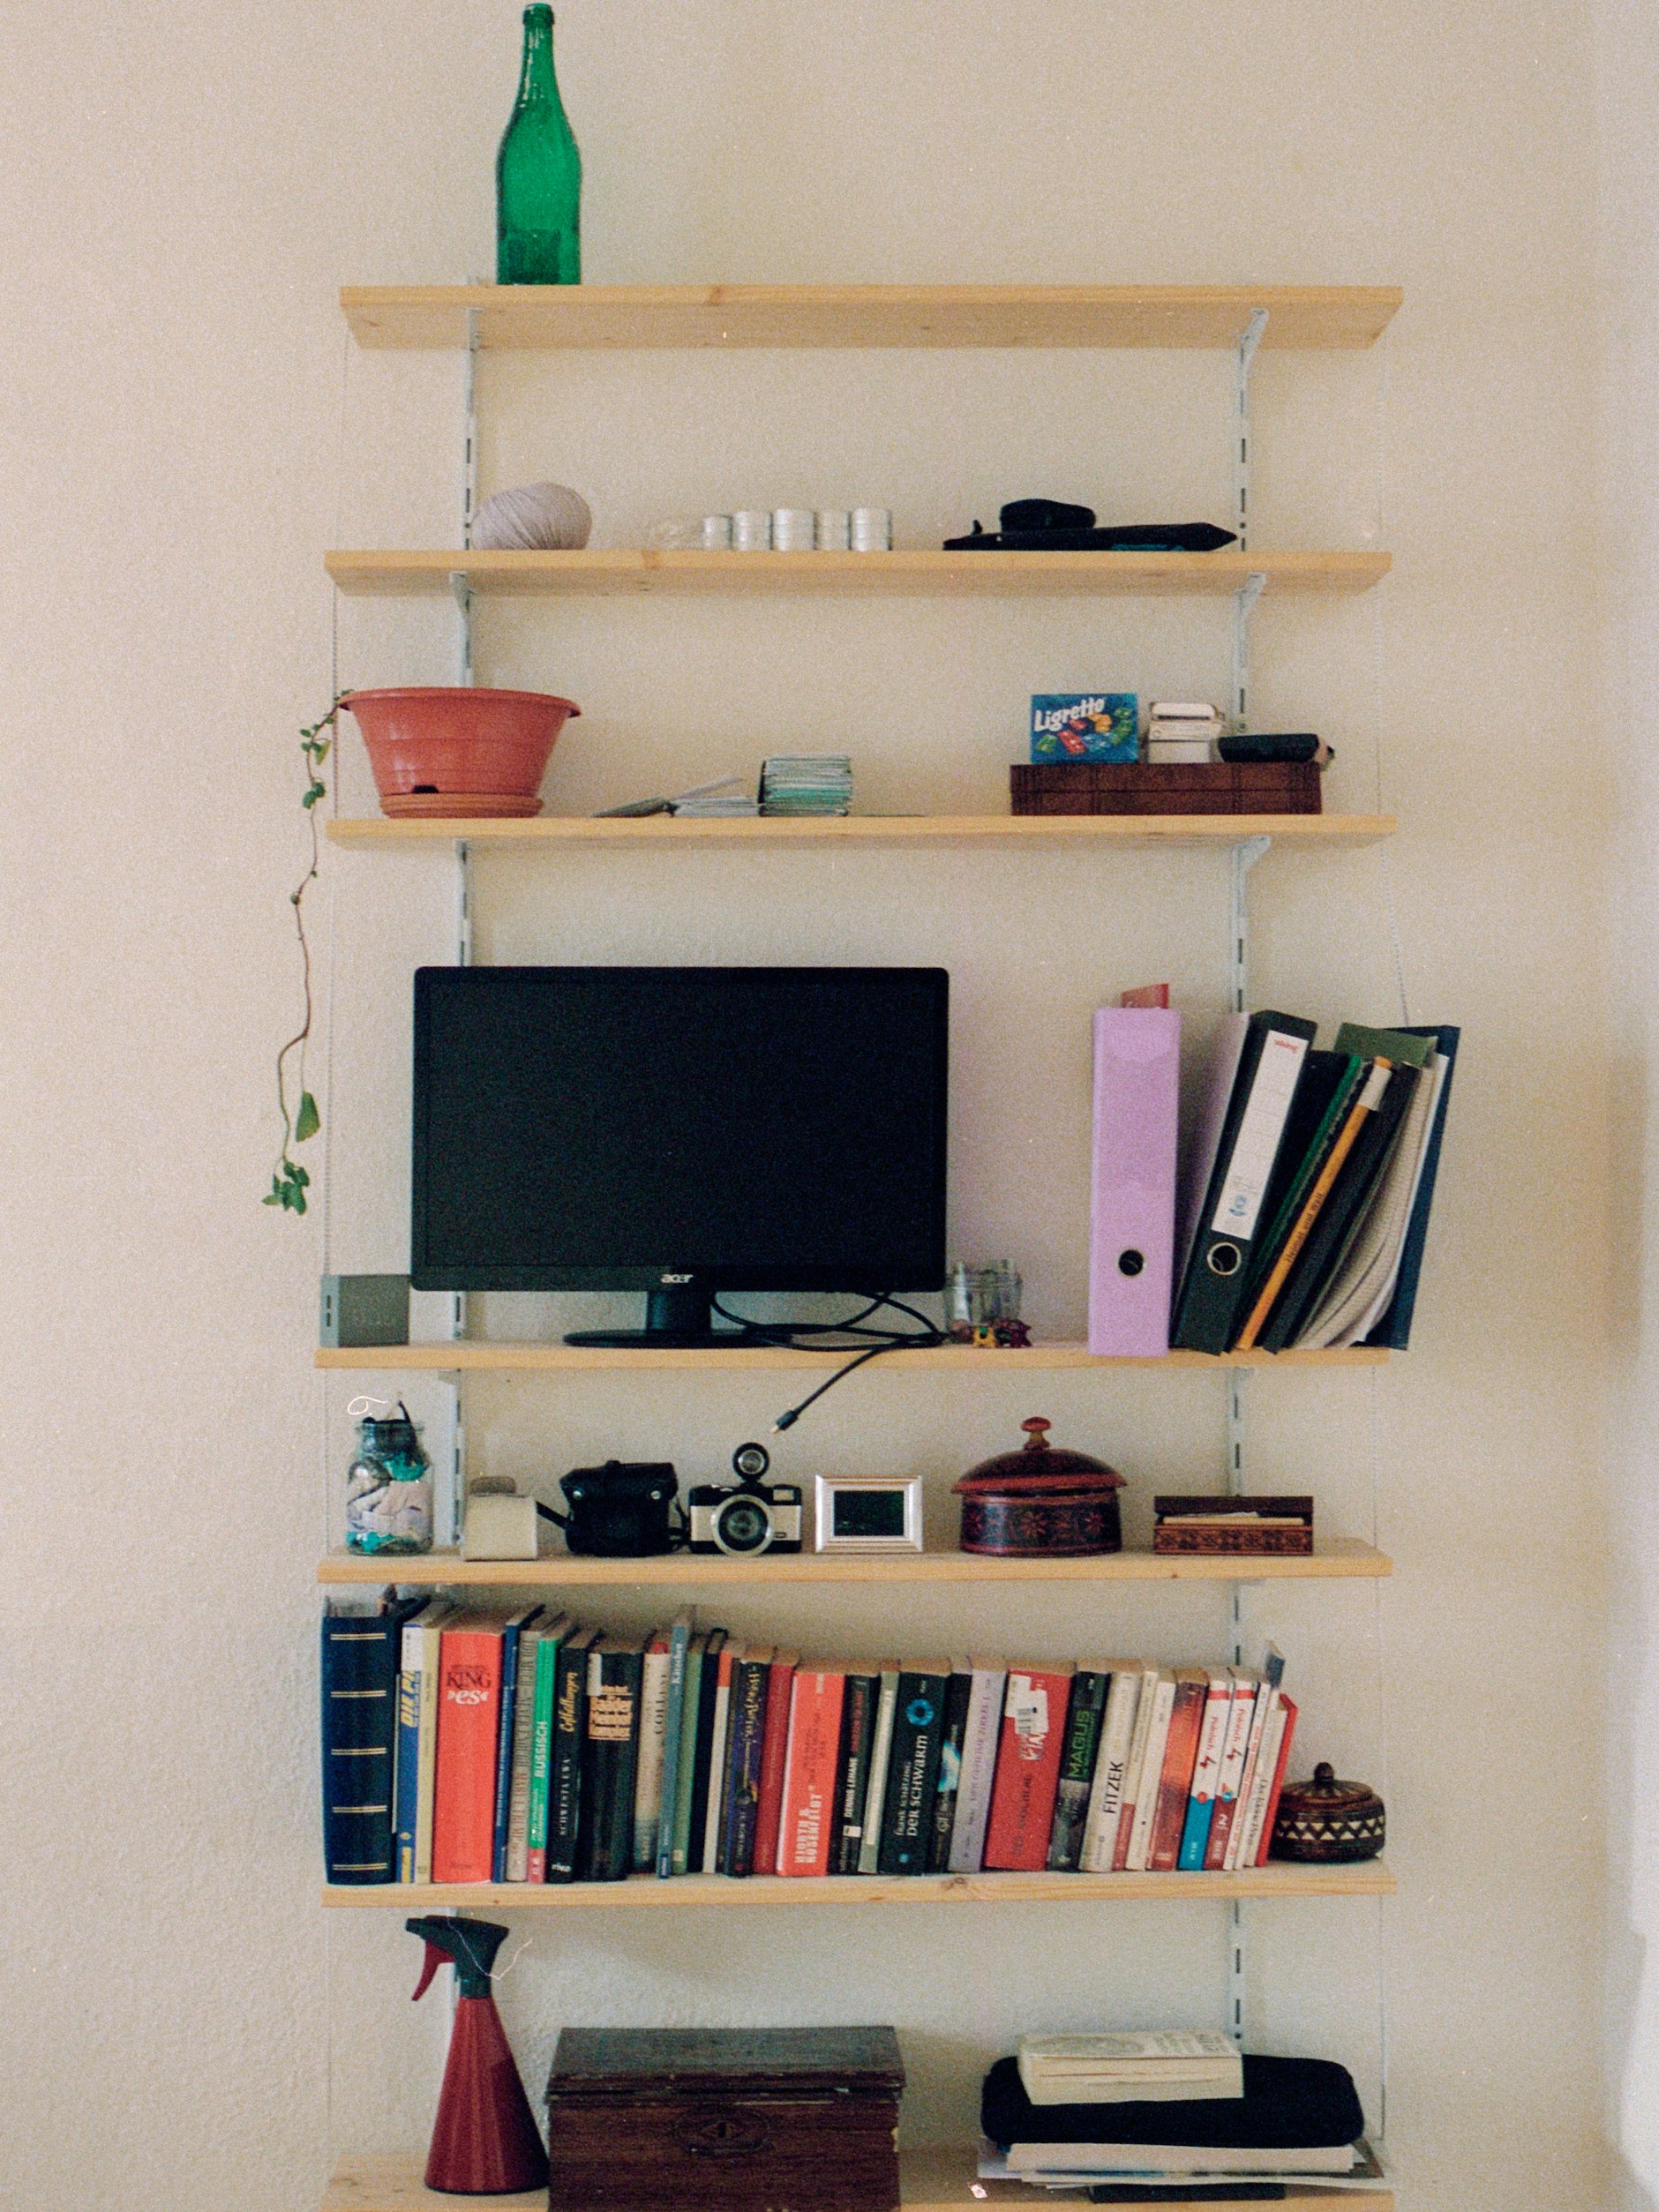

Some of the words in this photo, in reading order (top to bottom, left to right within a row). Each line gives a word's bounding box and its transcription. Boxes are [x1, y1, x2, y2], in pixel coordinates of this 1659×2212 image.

[1034, 697, 1105, 731] Ligretto
[1303, 1214, 1313, 1229] und
[660, 1271, 694, 1284] acer
[447, 1671, 492, 1689] KING
[533, 1721, 548, 1778] RUSSISCH
[1067, 1709, 1090, 1778] MAGUS
[846, 1758, 858, 1788] LEHANE
[1103, 1761, 1123, 1814] FITZEK
[559, 1783, 570, 1836] SCHWESTA
[844, 1788, 855, 1818] DENNIS
